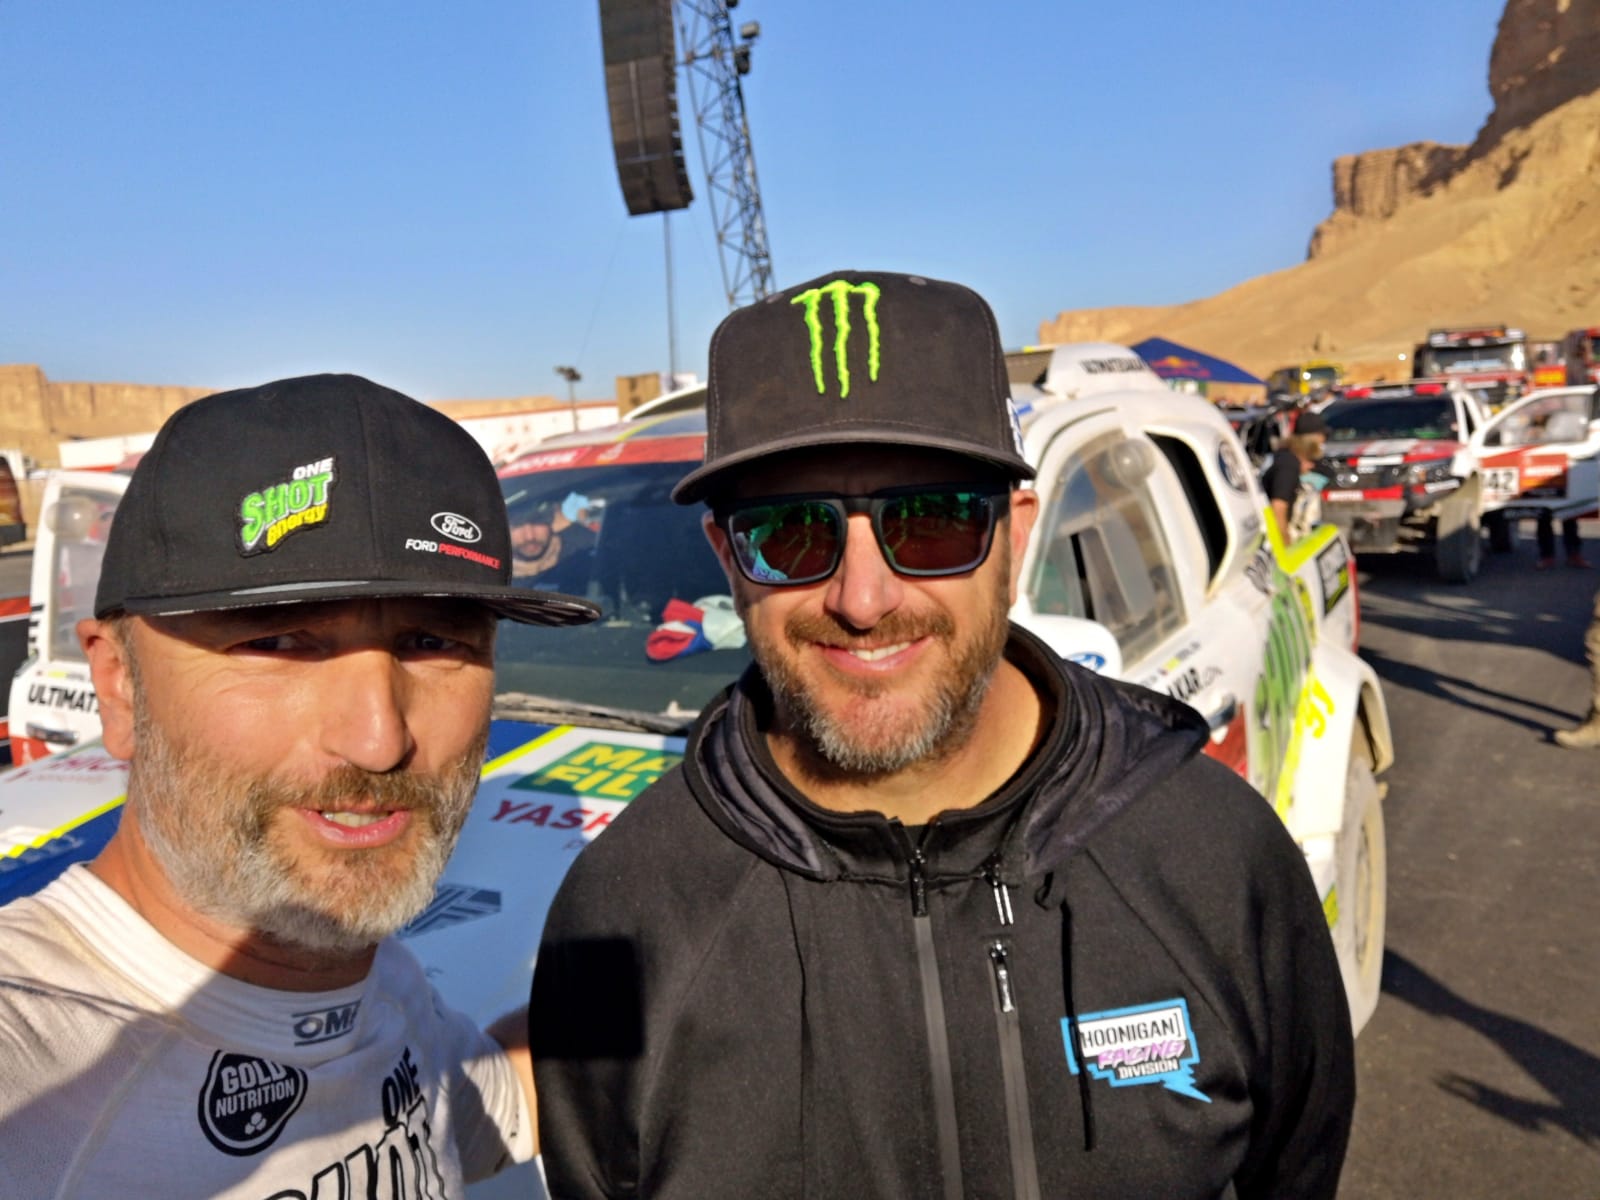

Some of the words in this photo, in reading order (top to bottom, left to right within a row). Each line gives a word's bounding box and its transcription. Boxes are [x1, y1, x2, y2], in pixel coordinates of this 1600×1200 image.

[293, 457, 333, 480] ONE
[241, 471, 334, 551] SHOT
[266, 502, 328, 547] energy
[441, 515, 475, 540] Ford
[405, 538, 438, 552] FORD
[28, 683, 100, 714] ULTIMAT
[532, 764, 659, 797] FIL
[1117, 1058, 1178, 1080] DIVISION
[215, 1077, 295, 1118] NUTRITION
[382, 1046, 421, 1127] ONE
